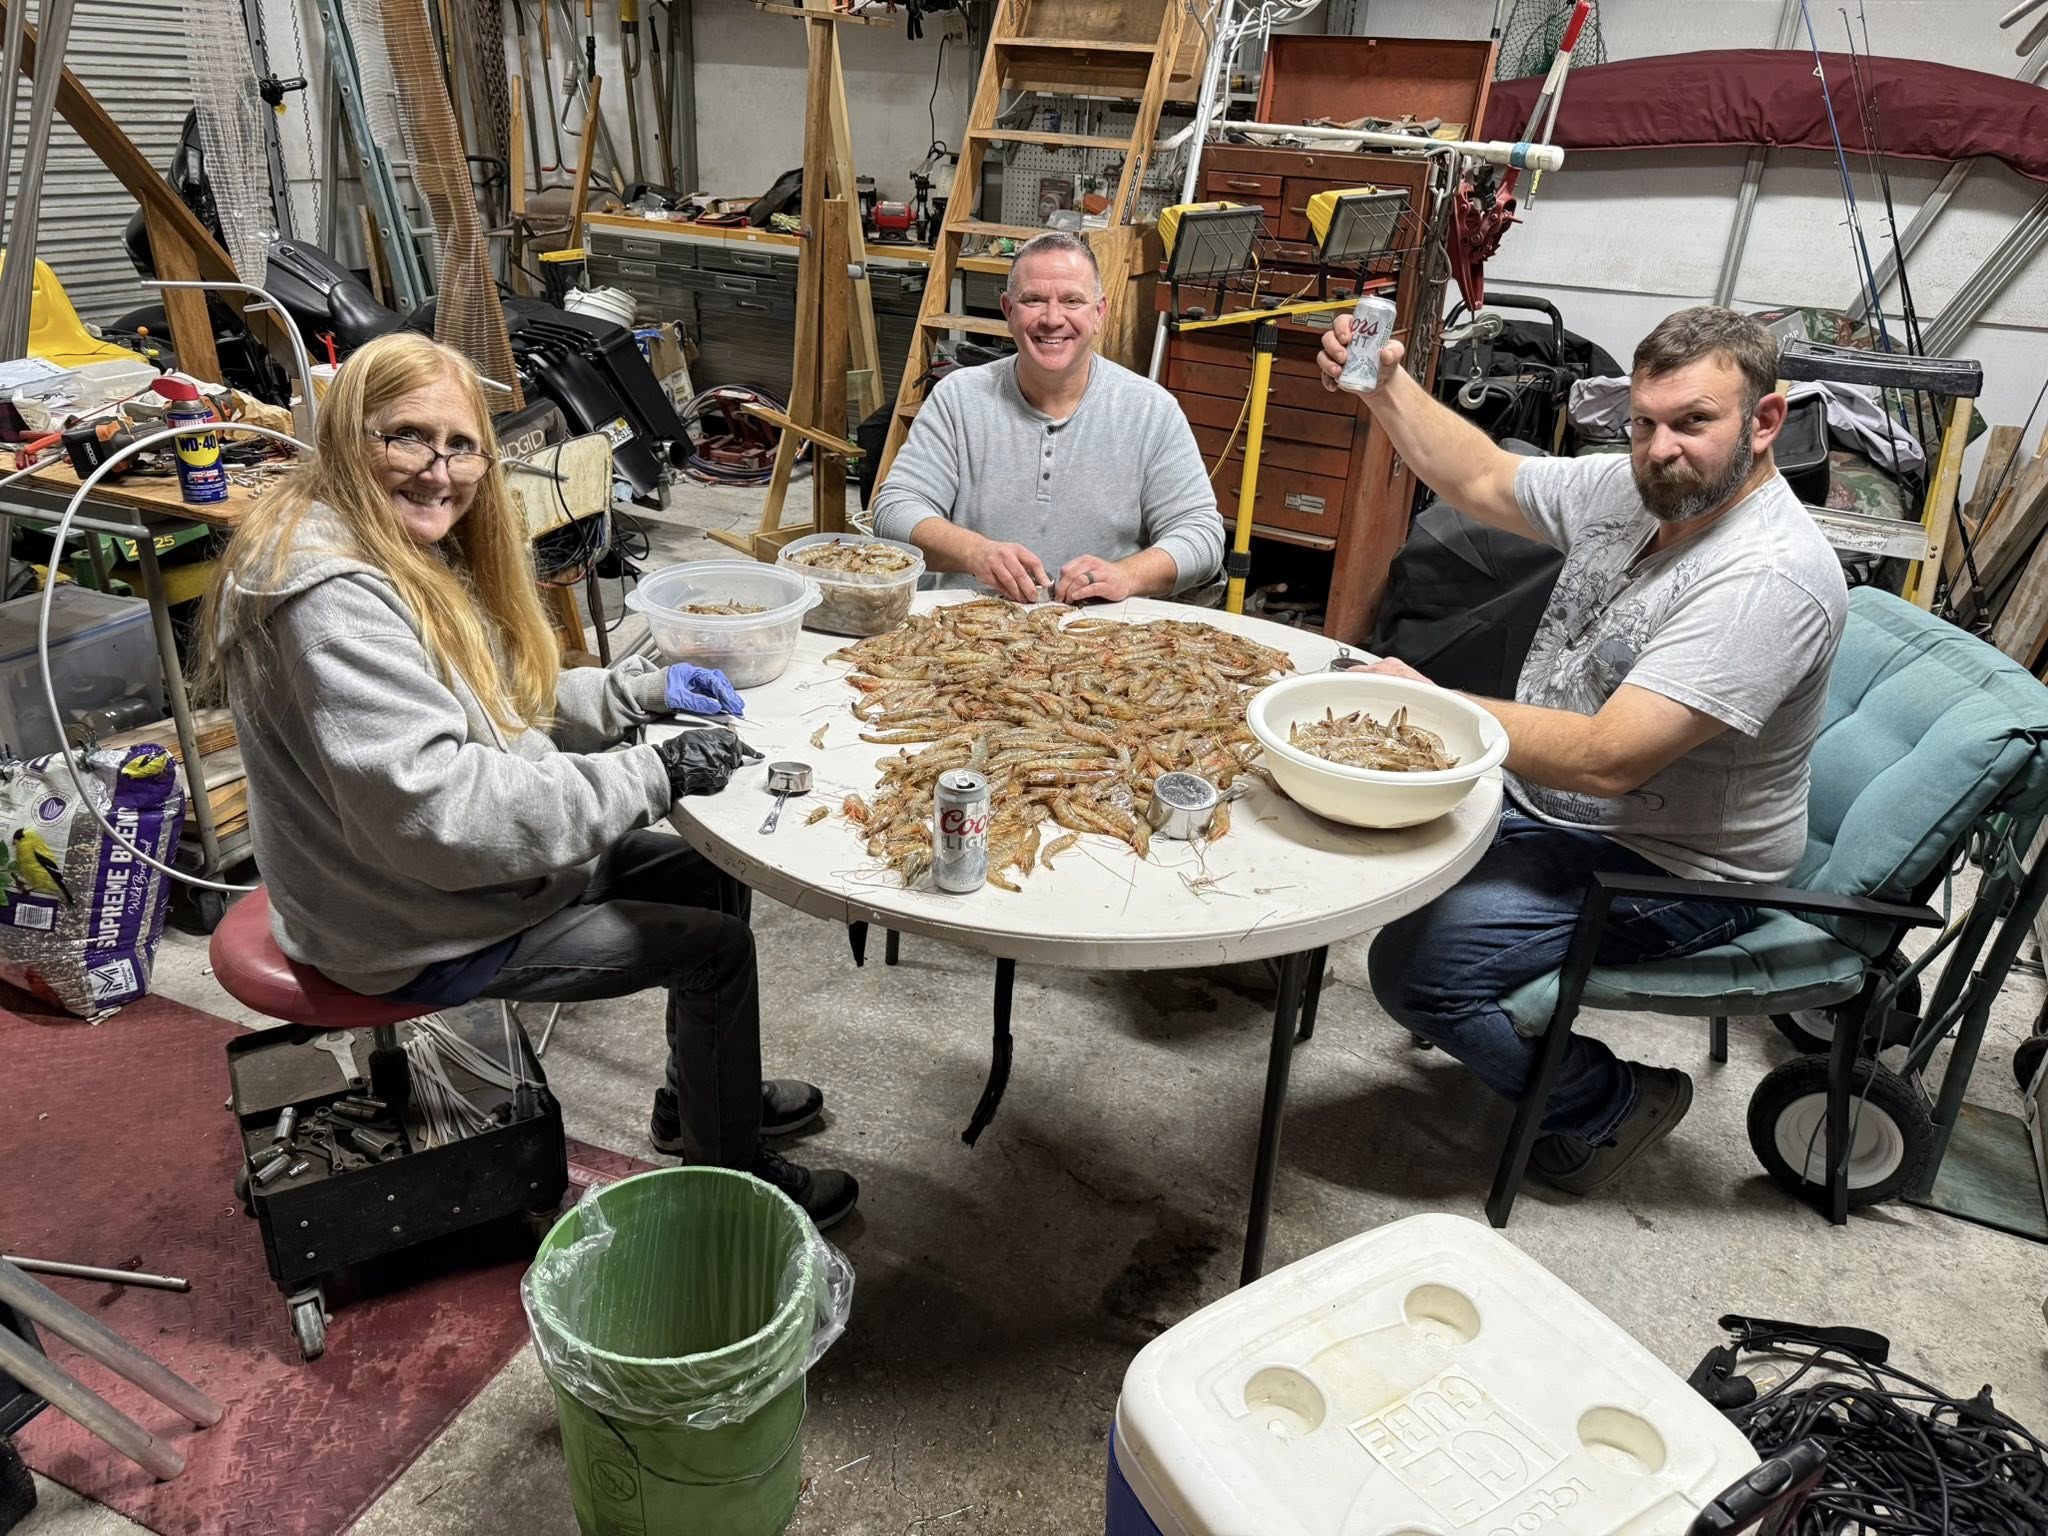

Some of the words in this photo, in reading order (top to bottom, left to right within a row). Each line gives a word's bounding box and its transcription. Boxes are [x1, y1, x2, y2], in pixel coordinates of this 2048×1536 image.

[1349, 319, 1379, 336] ors
[83, 441, 98, 466] RIDGID
[178, 434, 217, 452] WD-40
[940, 808, 988, 837] Coo
[944, 833, 988, 851] LIGH
[132, 860, 149, 885] Bird
[97, 868, 131, 949] SUPREME
[128, 885, 144, 915] Wild
[1352, 1375, 1486, 1460] CUBE
[1401, 1409, 1560, 1520] ICE
